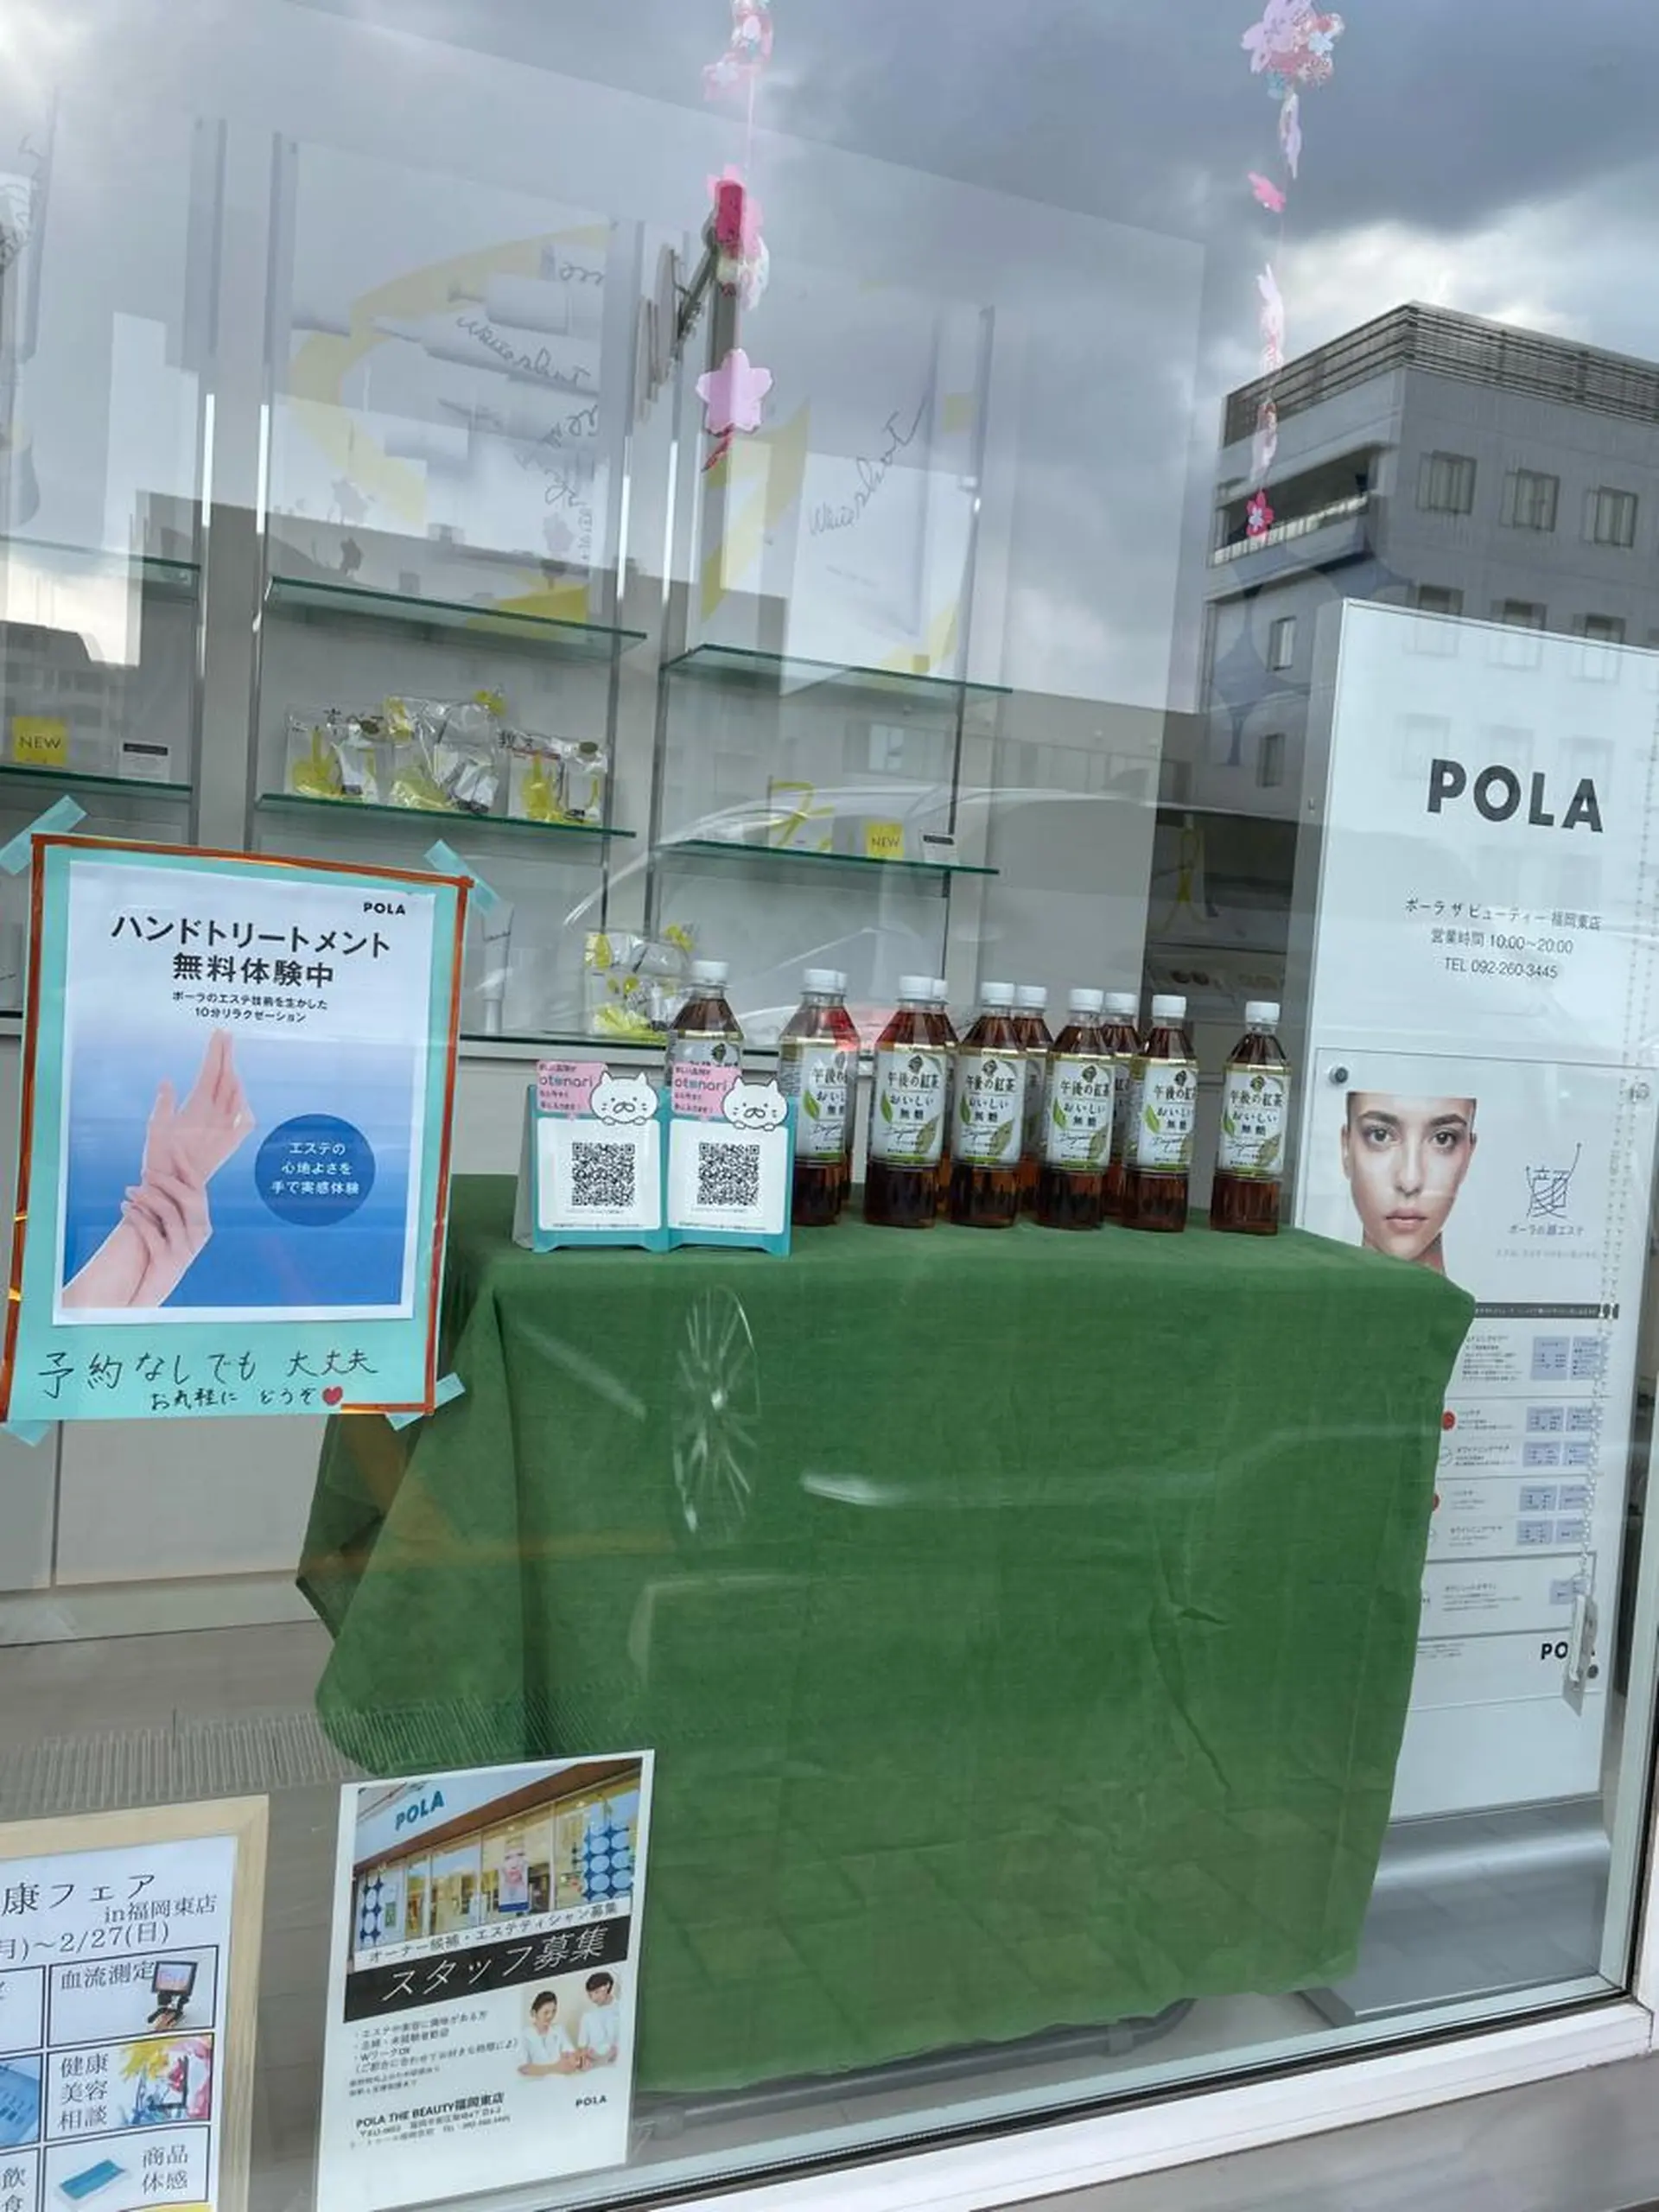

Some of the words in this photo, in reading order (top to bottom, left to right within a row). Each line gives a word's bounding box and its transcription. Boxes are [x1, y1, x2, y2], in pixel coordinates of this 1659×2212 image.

[19, 735, 60, 750] NEW
[1427, 759, 1603, 832] POLA
[871, 836, 899, 849] NEW
[364, 902, 406, 916] POLA
[1406, 899, 1446, 916] ポーラ
[1469, 906, 1546, 924] ビューティー
[1552, 911, 1602, 931] 福岡東店
[111, 916, 390, 958] ハンドトリートメント
[1431, 927, 1484, 947] 営業時間
[172, 952, 334, 988] 無料体験中
[1445, 957, 1466, 973] TEL
[195, 1007, 307, 1023] 10分リラクゼーション
[890, 1094, 934, 1108] おいしい
[969, 1097, 1009, 1110] おいしい
[1063, 1103, 1106, 1116] おいしい
[1232, 1109, 1279, 1125] おいしい
[289, 1141, 346, 1156] エステの
[281, 1160, 352, 1176] 心地よさを
[270, 1179, 359, 1196] 手で実感体験
[39, 1351, 256, 1400] 予約なしでも
[287, 1350, 378, 1379] 大丈夫
[150, 1389, 237, 1412] お気軽に
[258, 1387, 319, 1406] どうぞ
[395, 1789, 445, 1832] POLA
[2, 1873, 156, 1917] 康フェア
[105, 1895, 218, 1924] in福岡東店
[370, 1902, 619, 1963] オーナー候補・エステティシャン募集
[382, 1925, 607, 2002] スタッフ募集
[60, 1961, 155, 1991] 血流測定
[61, 2053, 109, 2078] 健康
[62, 2080, 108, 2104] 美容
[59, 2106, 107, 2132] 相談
[356, 2115, 385, 2129] POLA
[389, 2110, 410, 2122] THE
[143, 2144, 188, 2167] 商品
[143, 2169, 188, 2195] 体感
